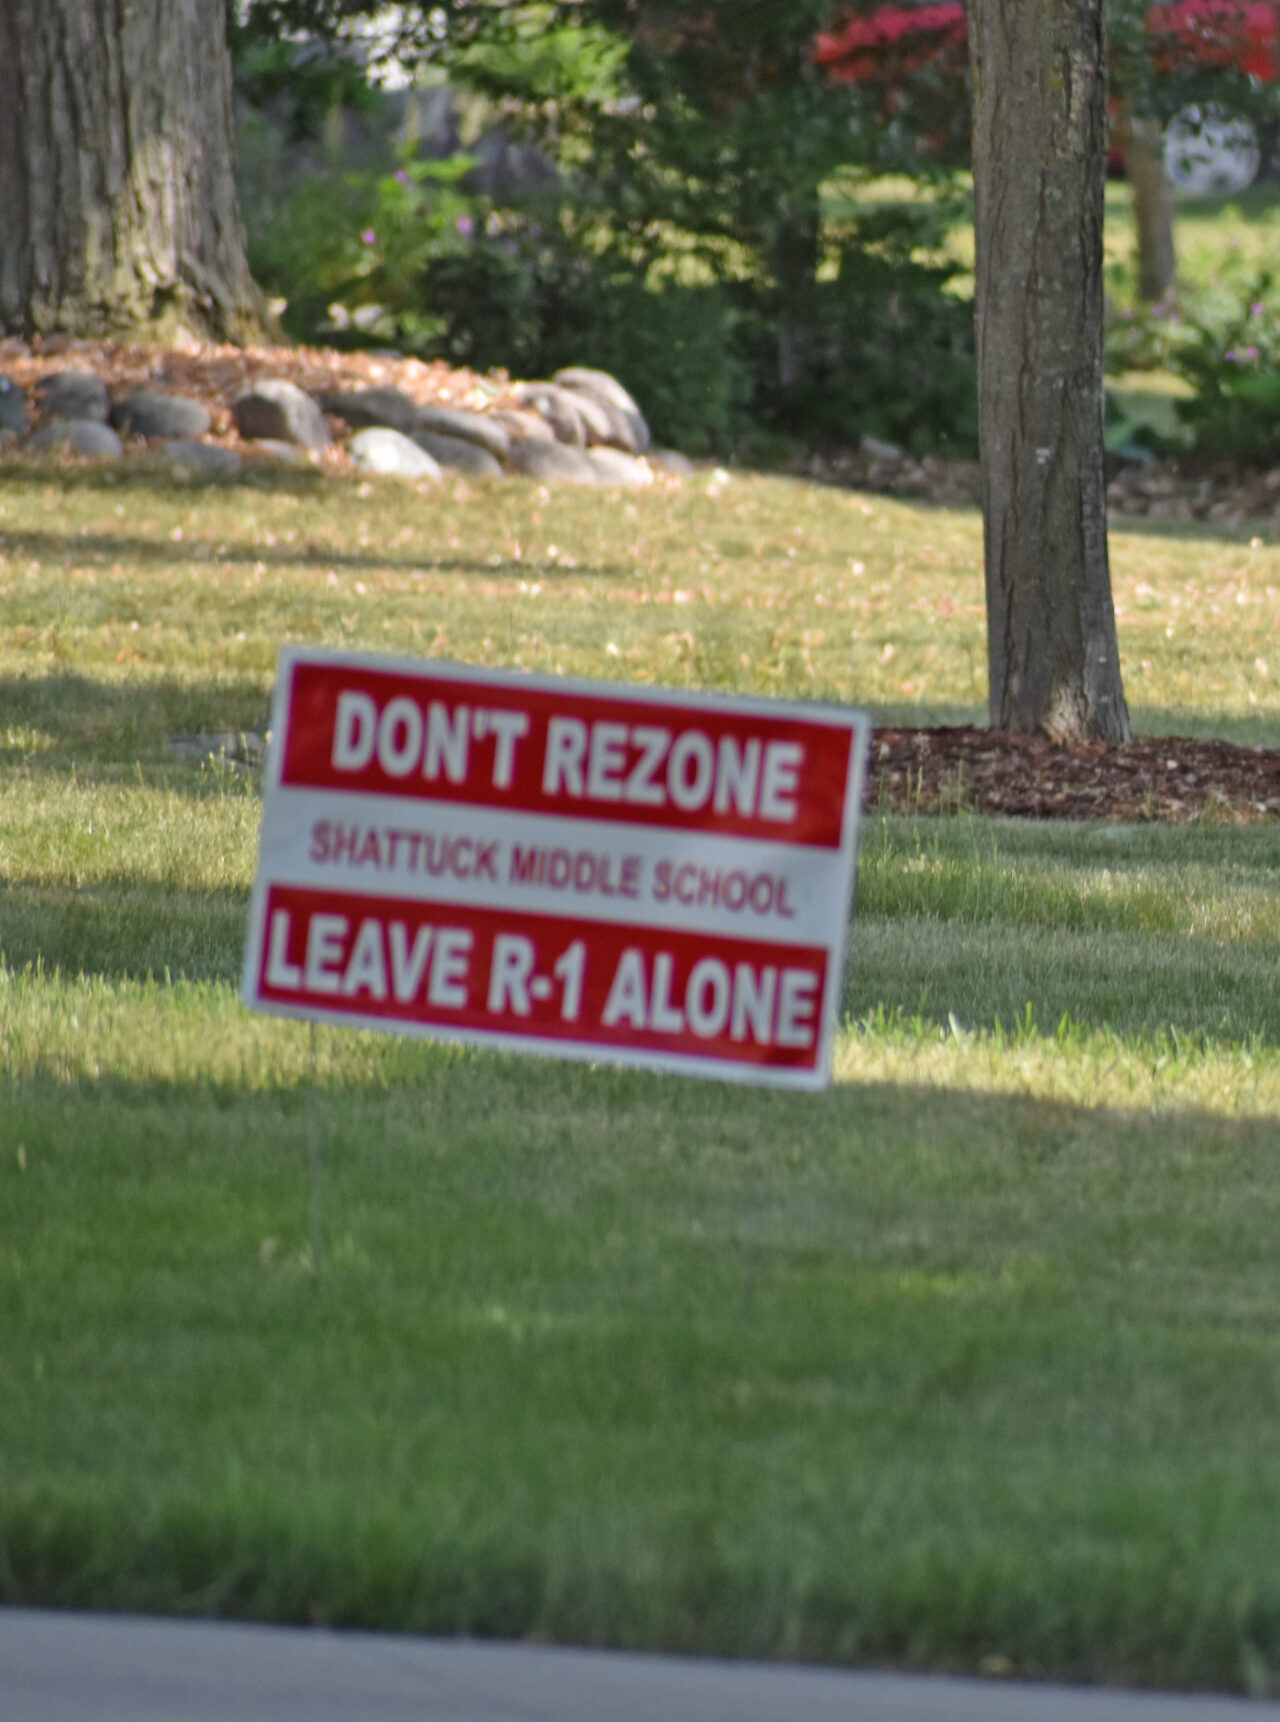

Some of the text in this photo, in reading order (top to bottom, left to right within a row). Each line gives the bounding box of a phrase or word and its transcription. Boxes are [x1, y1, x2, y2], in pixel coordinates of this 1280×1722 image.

[331, 690, 804, 823] DON'T REZONE
[310, 820, 795, 917] SHATTUCK MIDDLE SCHOOL
[266, 908, 818, 1048] LEAVE R-1 ALONE
